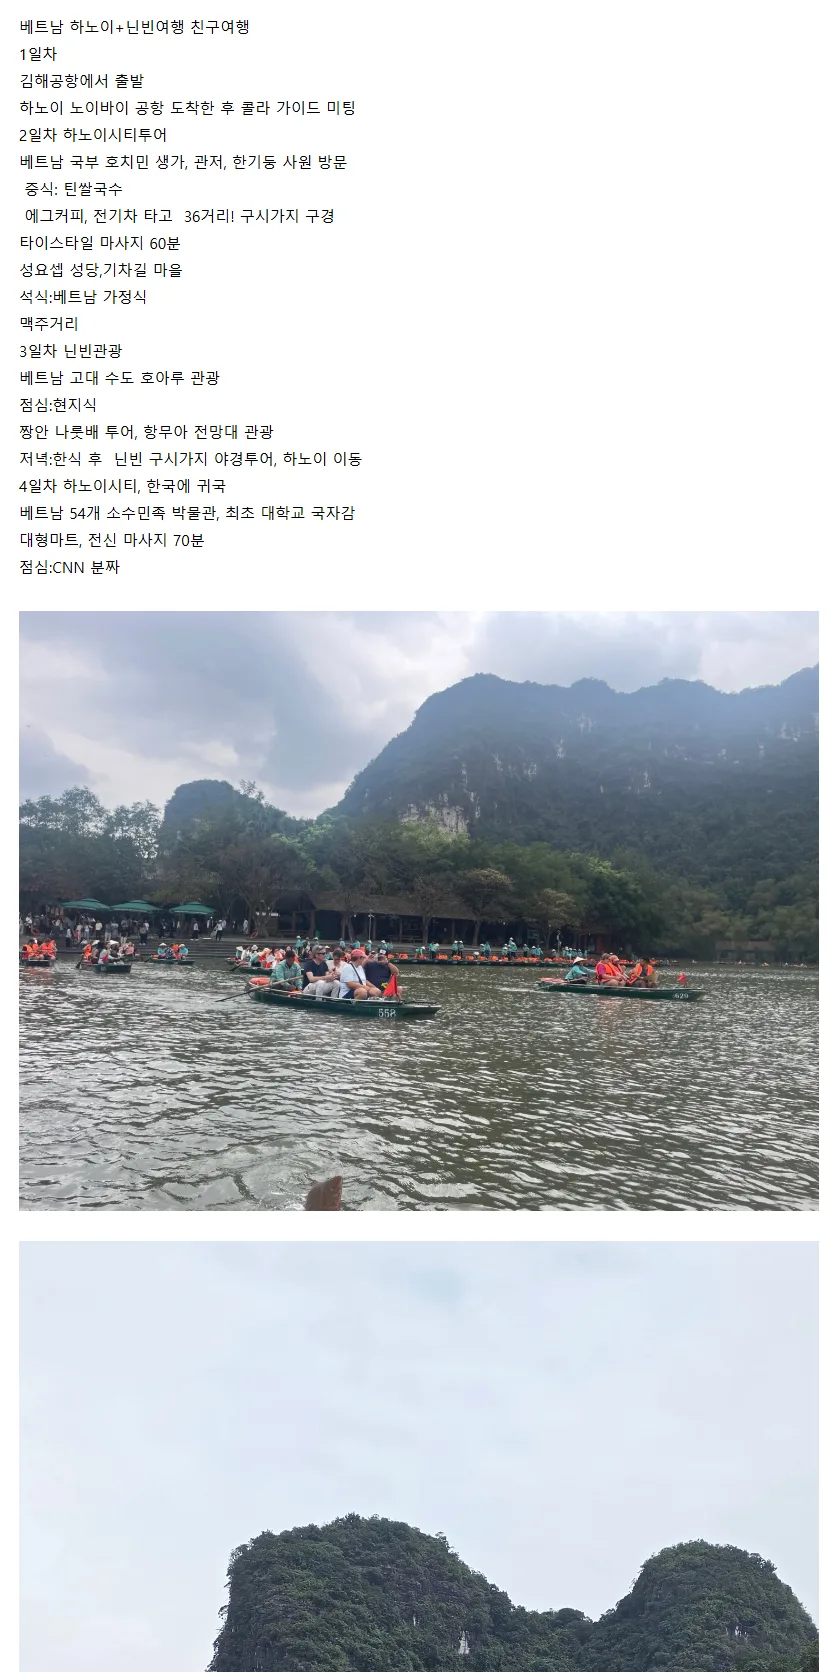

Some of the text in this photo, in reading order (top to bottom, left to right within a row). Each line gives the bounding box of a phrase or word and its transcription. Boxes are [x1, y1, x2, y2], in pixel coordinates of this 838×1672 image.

[21, 20, 248, 34] 베트남 하노이+닌빈여행 친구여행
[20, 47, 57, 61] 1일차
[21, 74, 144, 88] 김해공항에서 출발
[20, 101, 356, 115] 하노이 노이바이 공항 도착한 후 콜라 가이드 미팅
[20, 128, 167, 142] 2일차 하노이시티투어
[21, 155, 347, 170] 베트남 국부 호치민 생가, 관저, 한기둥 사원 방문
[25, 182, 122, 196] 중식: 틴쌀국수
[26, 209, 333, 224] 에그커피, 전기차 타고 36거리! 구시가지 구경
[21, 236, 180, 250] 타이스타일 마사지 60분
[20, 263, 182, 278] 성요셉 성당,기차길 마을
[20, 290, 145, 304] 석식:베트남 가정식
[21, 317, 77, 331] 맥주거리
[20, 344, 122, 358] 3일차 닌빈관광
[21, 371, 220, 385] 베트남 고대 수도 호아루 관광
[20, 398, 95, 412] 점심:현지식
[20, 425, 273, 440] 짱안 나룻배 투어, 항무아 전망대 관광
[20, 452, 362, 467] 저녁:한식 후 닌빈 구시가지 야경투어, 하노이 이동
[19, 479, 226, 494] 4일차 하노이시티, 한국에 귀국
[21, 506, 355, 521] 베트남 54개 소수민족 박물관, 최초 대학교 국자감
[21, 533, 204, 548] 대형마트, 전신 마사지 70분
[20, 560, 120, 574] 점심:CNN 분짜
[378, 1008, 397, 1018] 558
